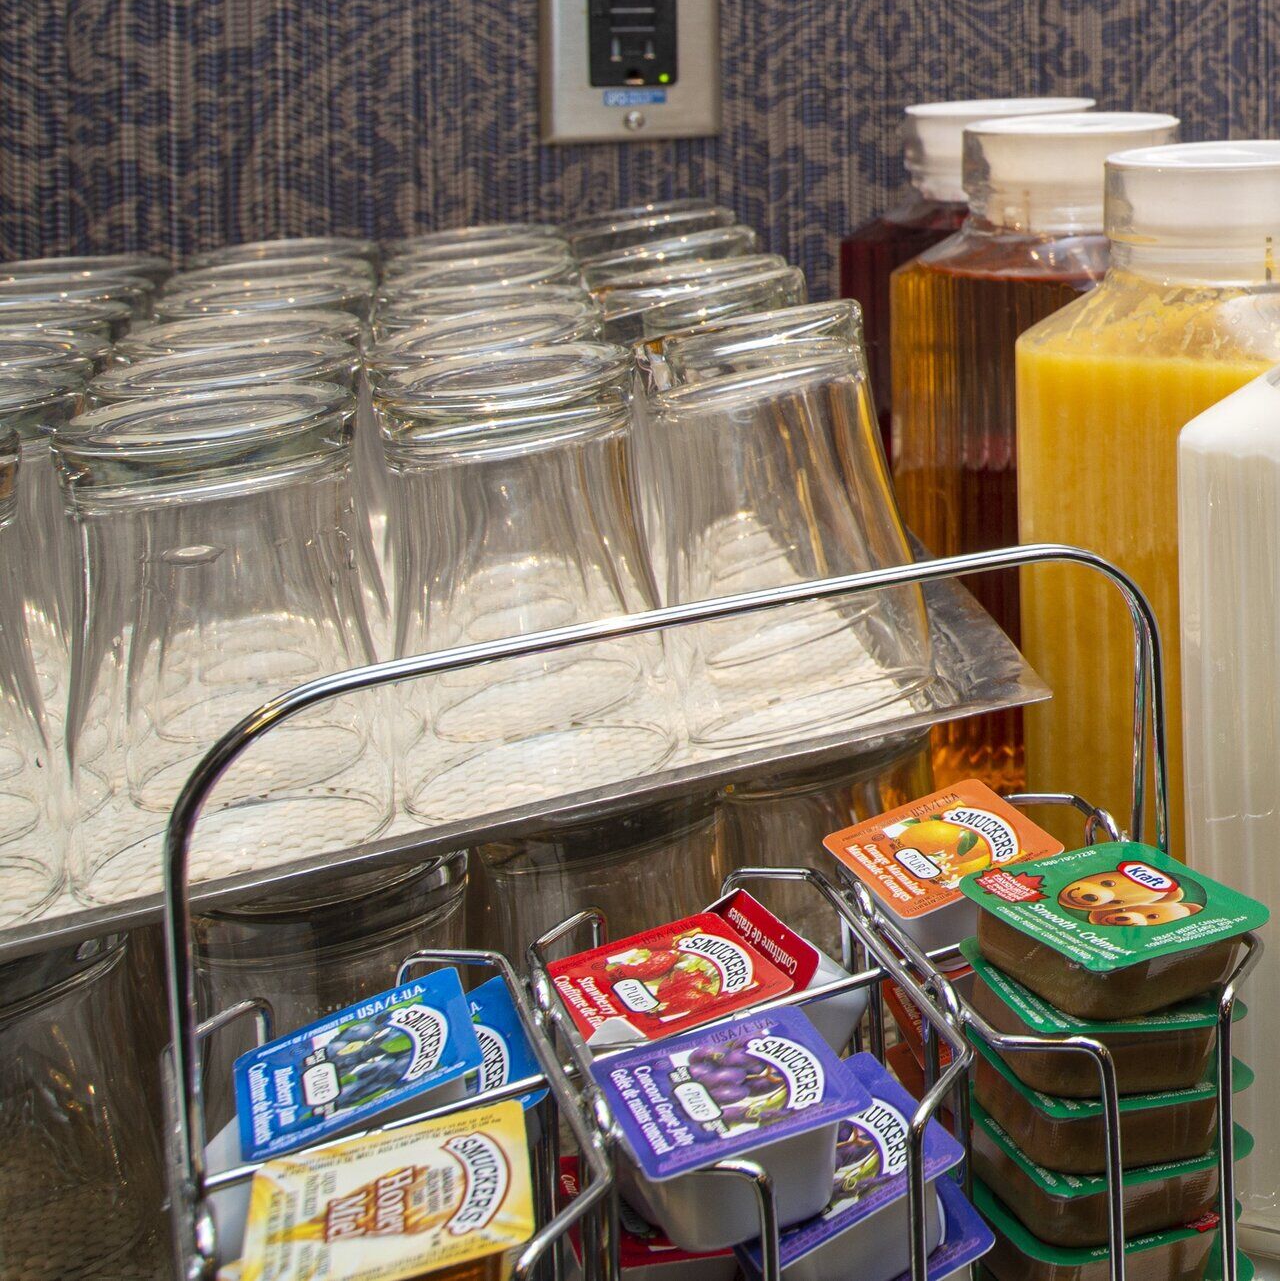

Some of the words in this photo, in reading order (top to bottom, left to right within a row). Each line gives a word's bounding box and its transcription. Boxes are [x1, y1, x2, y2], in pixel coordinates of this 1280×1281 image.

[951, 809, 1013, 862] SMUCKER'S
[845, 844, 885, 877] Marmelade
[880, 872, 912, 903] d'oranges
[864, 843, 889, 866] Orange
[888, 863, 928, 896] Marmalade
[903, 853, 931, 873] PURE
[1128, 866, 1165, 887] Kraft
[728, 906, 751, 936] fraises
[1028, 903, 1077, 931] Smooth
[689, 936, 746, 989] SMUCKER'S
[761, 938, 798, 975] Confiture
[554, 975, 588, 1012] Confiture
[577, 977, 617, 1018] Strawberry
[626, 985, 646, 1007] PURE
[397, 1009, 440, 1080] SMUCKER'S
[476, 1030, 505, 1090] MUCKER
[248, 1062, 270, 1107] Confiture
[273, 1063, 294, 1111] Blueberry
[309, 1070, 331, 1099] PURE
[755, 1040, 817, 1103] SMUCKER'S
[278, 1103, 298, 1128] Jam
[610, 1069, 632, 1093] Gelée
[630, 1097, 653, 1124] raisins
[642, 1119, 674, 1155] concord
[634, 1066, 662, 1105] Concord
[656, 1098, 681, 1127] Grape
[673, 1122, 695, 1147] Jelly
[686, 1091, 708, 1116] PURE
[254, 1111, 275, 1146] bleuets
[857, 1103, 906, 1171] UCKER'S
[376, 1166, 416, 1236] Honey
[454, 1138, 498, 1226] SMUCKER'S
[325, 1193, 368, 1243] Miel
